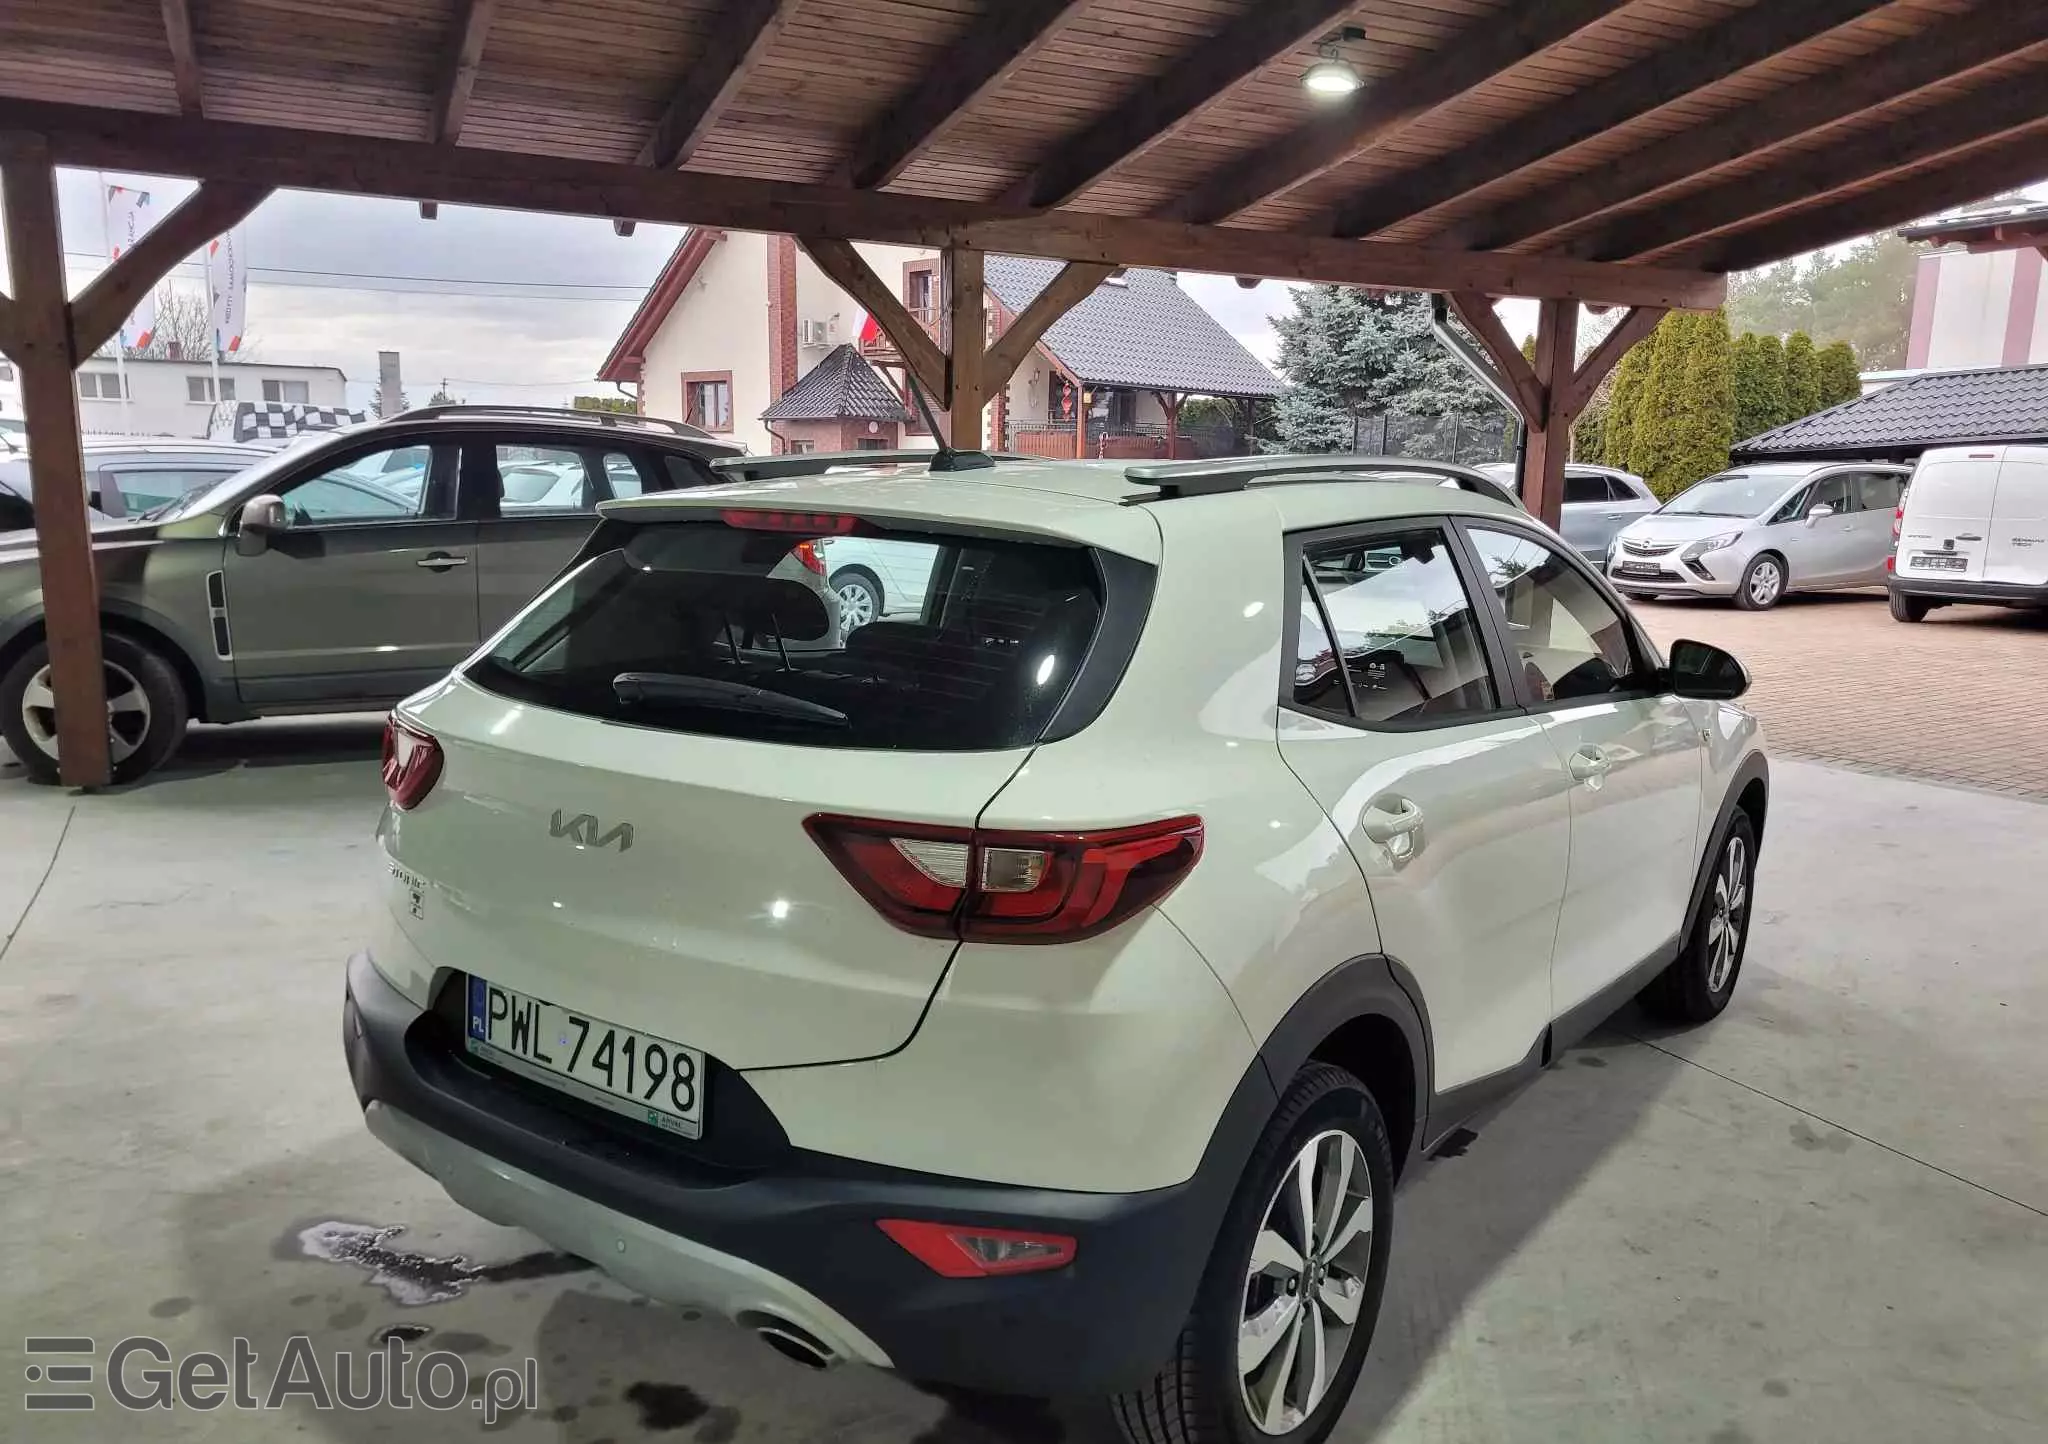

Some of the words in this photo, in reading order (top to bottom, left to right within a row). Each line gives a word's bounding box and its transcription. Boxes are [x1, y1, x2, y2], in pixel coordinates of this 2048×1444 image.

[549, 807, 634, 853] KIA
[472, 1015, 485, 1033] PL
[488, 986, 552, 1065] PWL
[566, 1015, 695, 1113] 74198
